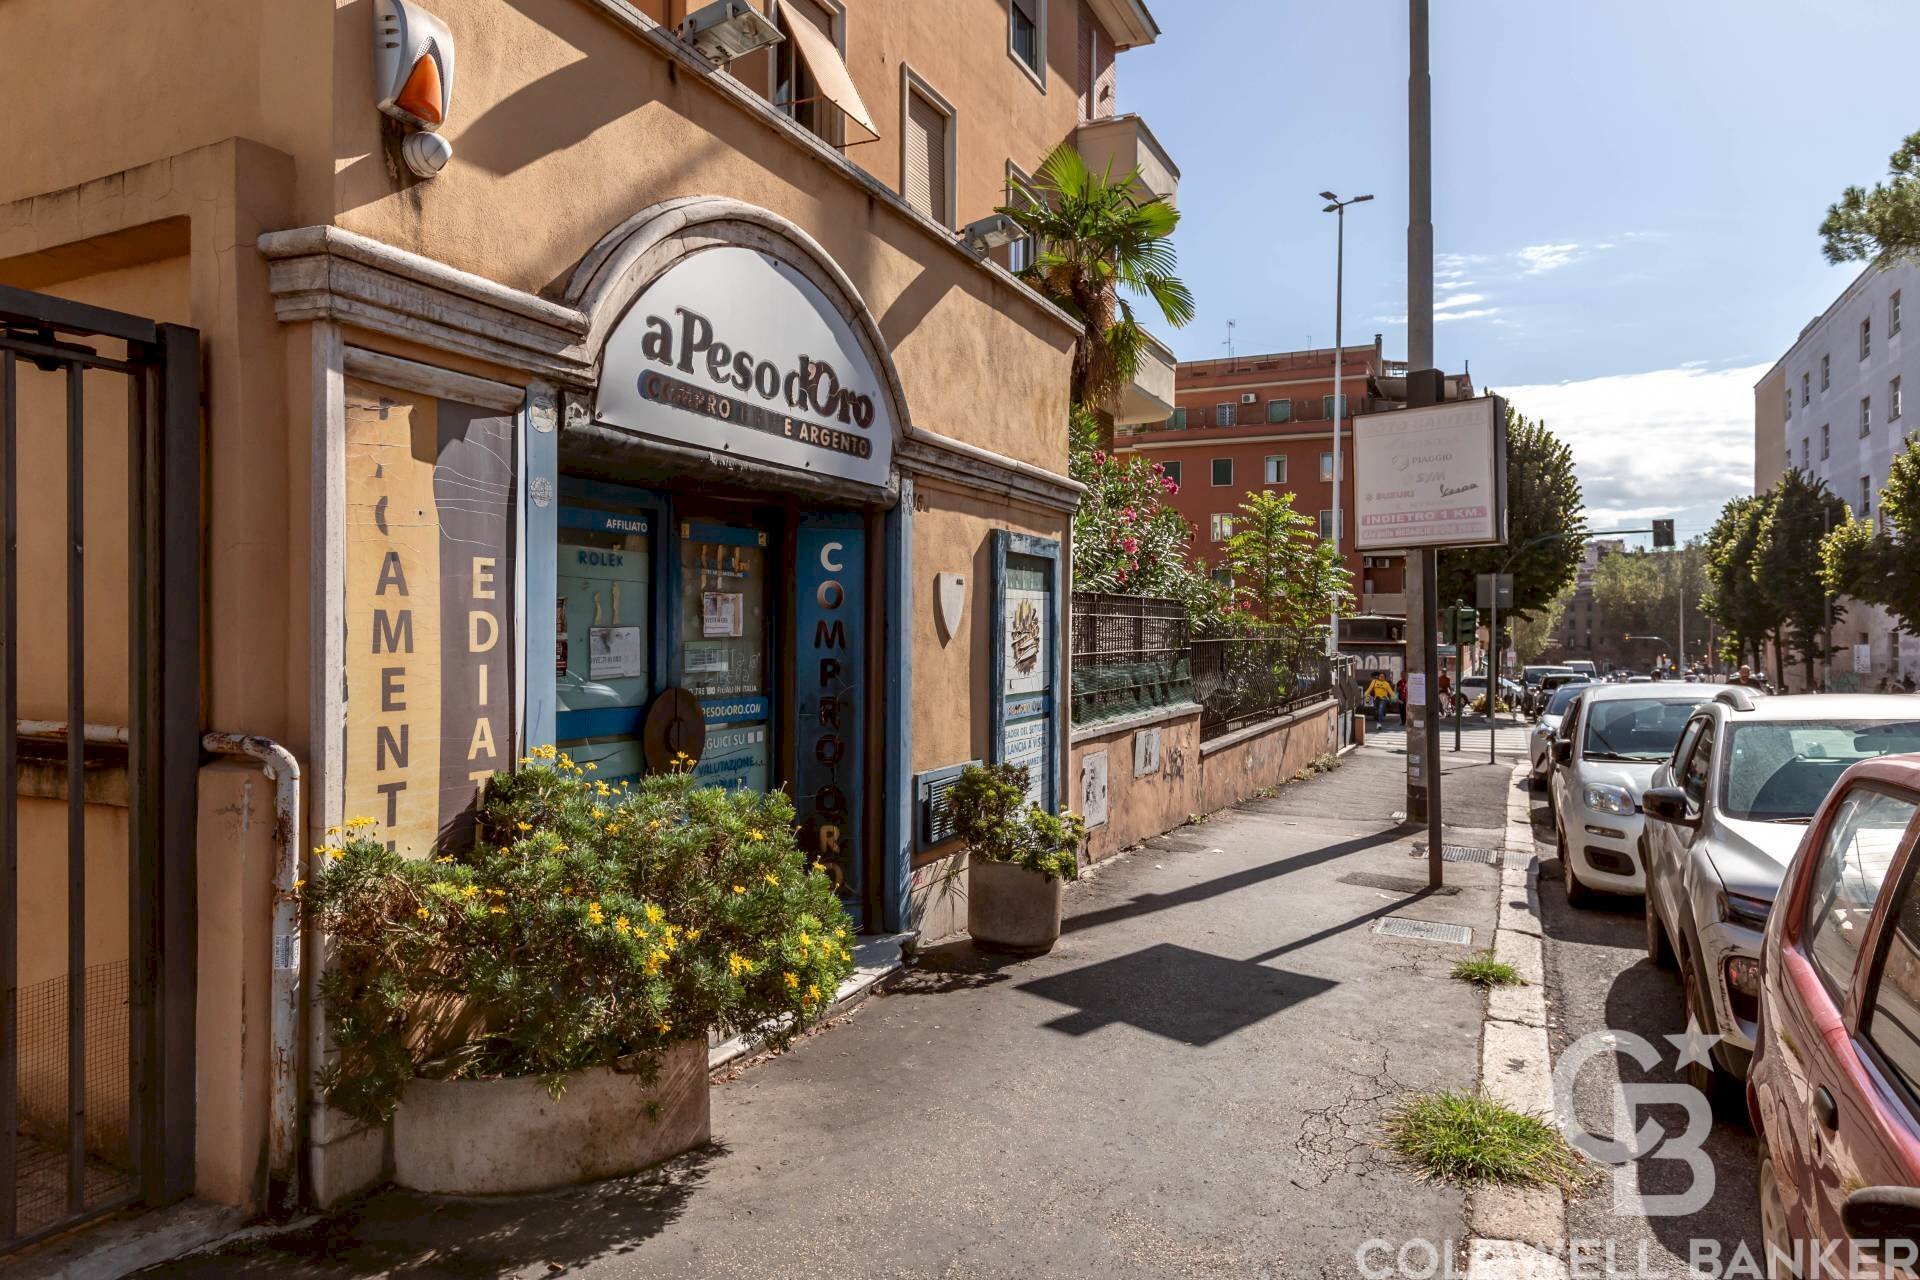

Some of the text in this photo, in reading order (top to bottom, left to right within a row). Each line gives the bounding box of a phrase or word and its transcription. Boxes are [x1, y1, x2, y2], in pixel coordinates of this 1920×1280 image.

[785, 417, 793, 436] E
[798, 421, 869, 456] ARGENTO
[1412, 453, 1453, 465] PIAGGIO
[1440, 483, 1480, 498] Vespa
[1366, 508, 1482, 525] INDIETRO 1 KM.
[606, 518, 648, 533] AFFILIATO
[577, 550, 624, 567] ROLEX
[814, 541, 847, 768] COMPRO
[742, 684, 758, 692] ITALIA
[1020, 726, 1028, 736] DEL
[704, 733, 745, 750] GUICI SU
[698, 756, 755, 778] VALUTAZIONE
